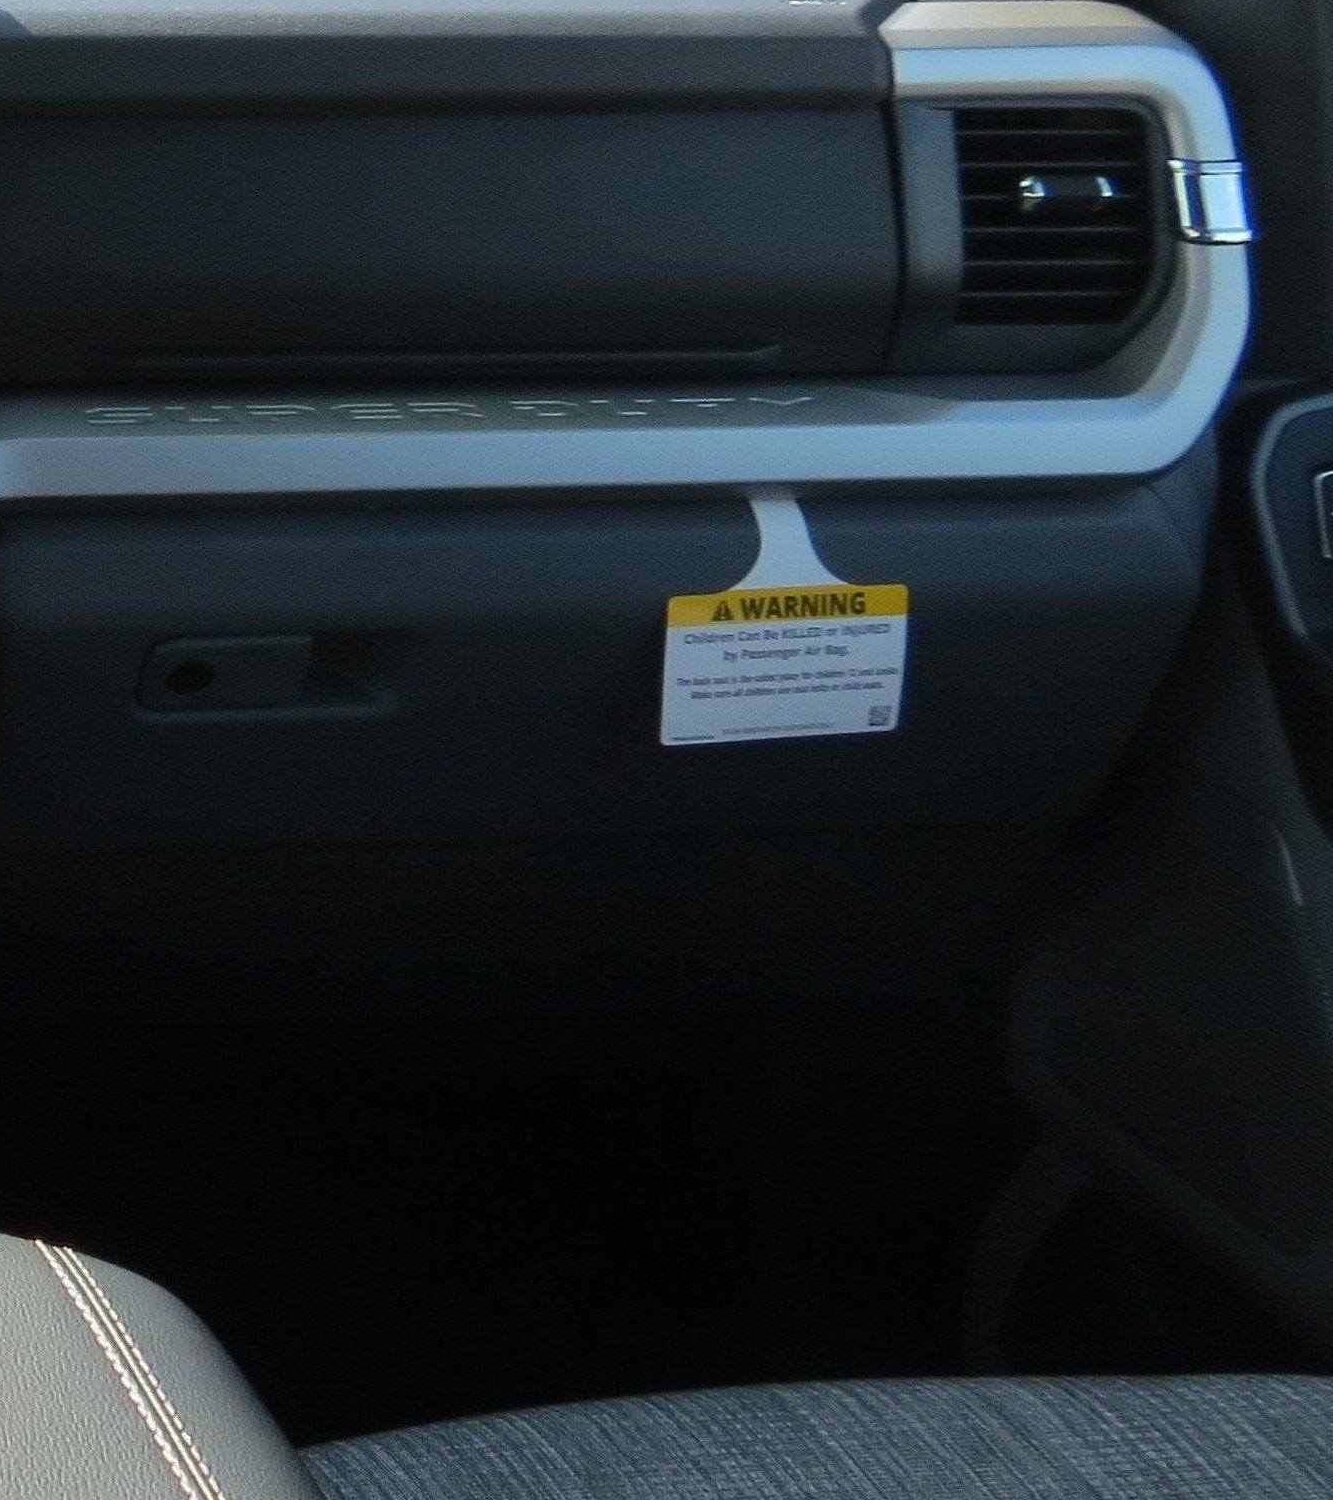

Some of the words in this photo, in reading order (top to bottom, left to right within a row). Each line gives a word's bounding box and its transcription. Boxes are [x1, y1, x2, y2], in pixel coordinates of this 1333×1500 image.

[740, 592, 866, 621] WARNING
[683, 632, 735, 645] Children
[738, 630, 761, 642] Can
